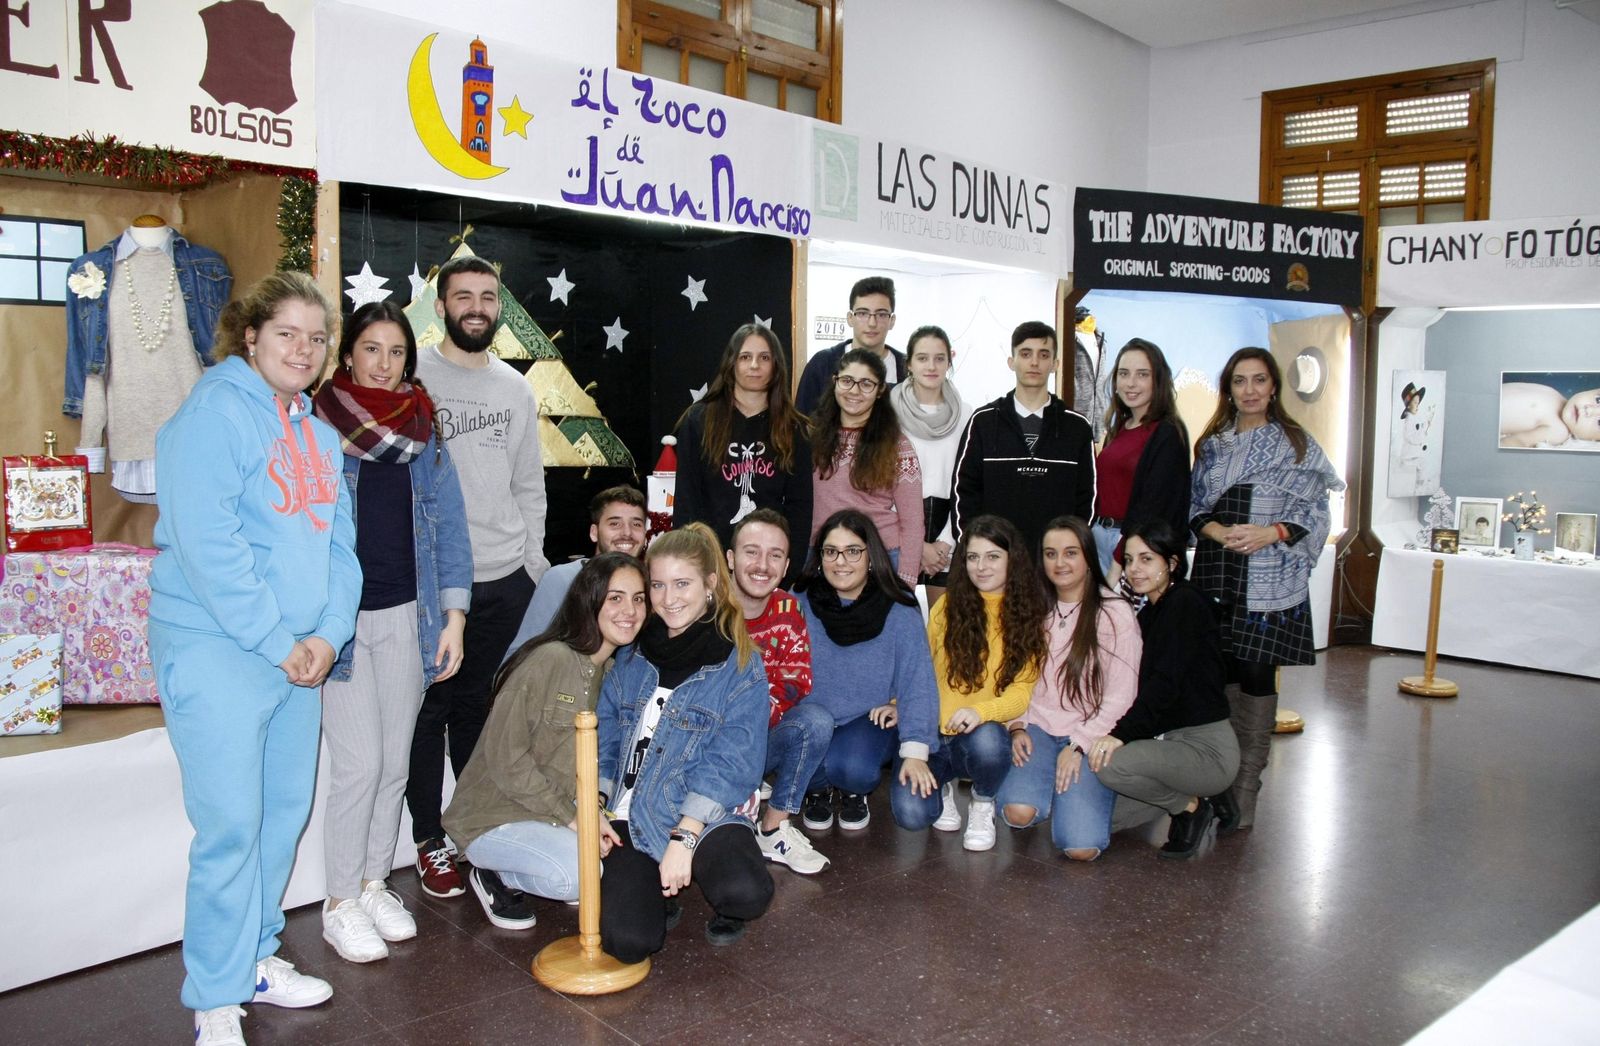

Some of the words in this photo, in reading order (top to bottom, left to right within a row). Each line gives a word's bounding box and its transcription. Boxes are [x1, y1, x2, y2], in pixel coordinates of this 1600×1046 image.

[632, 75, 726, 139] Zoco
[190, 105, 292, 147] BOLSOS
[878, 142, 936, 212] LAS
[953, 161, 1050, 235] DUNAS
[956, 224, 969, 243] DE
[1089, 210, 1133, 243] THE
[1141, 213, 1265, 252] ADVENTURE
[1272, 223, 1359, 259] FACTORY
[1387, 233, 1483, 265] CHANY
[1104, 259, 1164, 277] ORIGINAL
[1170, 262, 1270, 284] SPORTING-GOODS
[816, 322, 845, 335] 2019
[436, 408, 511, 441] Billabong
